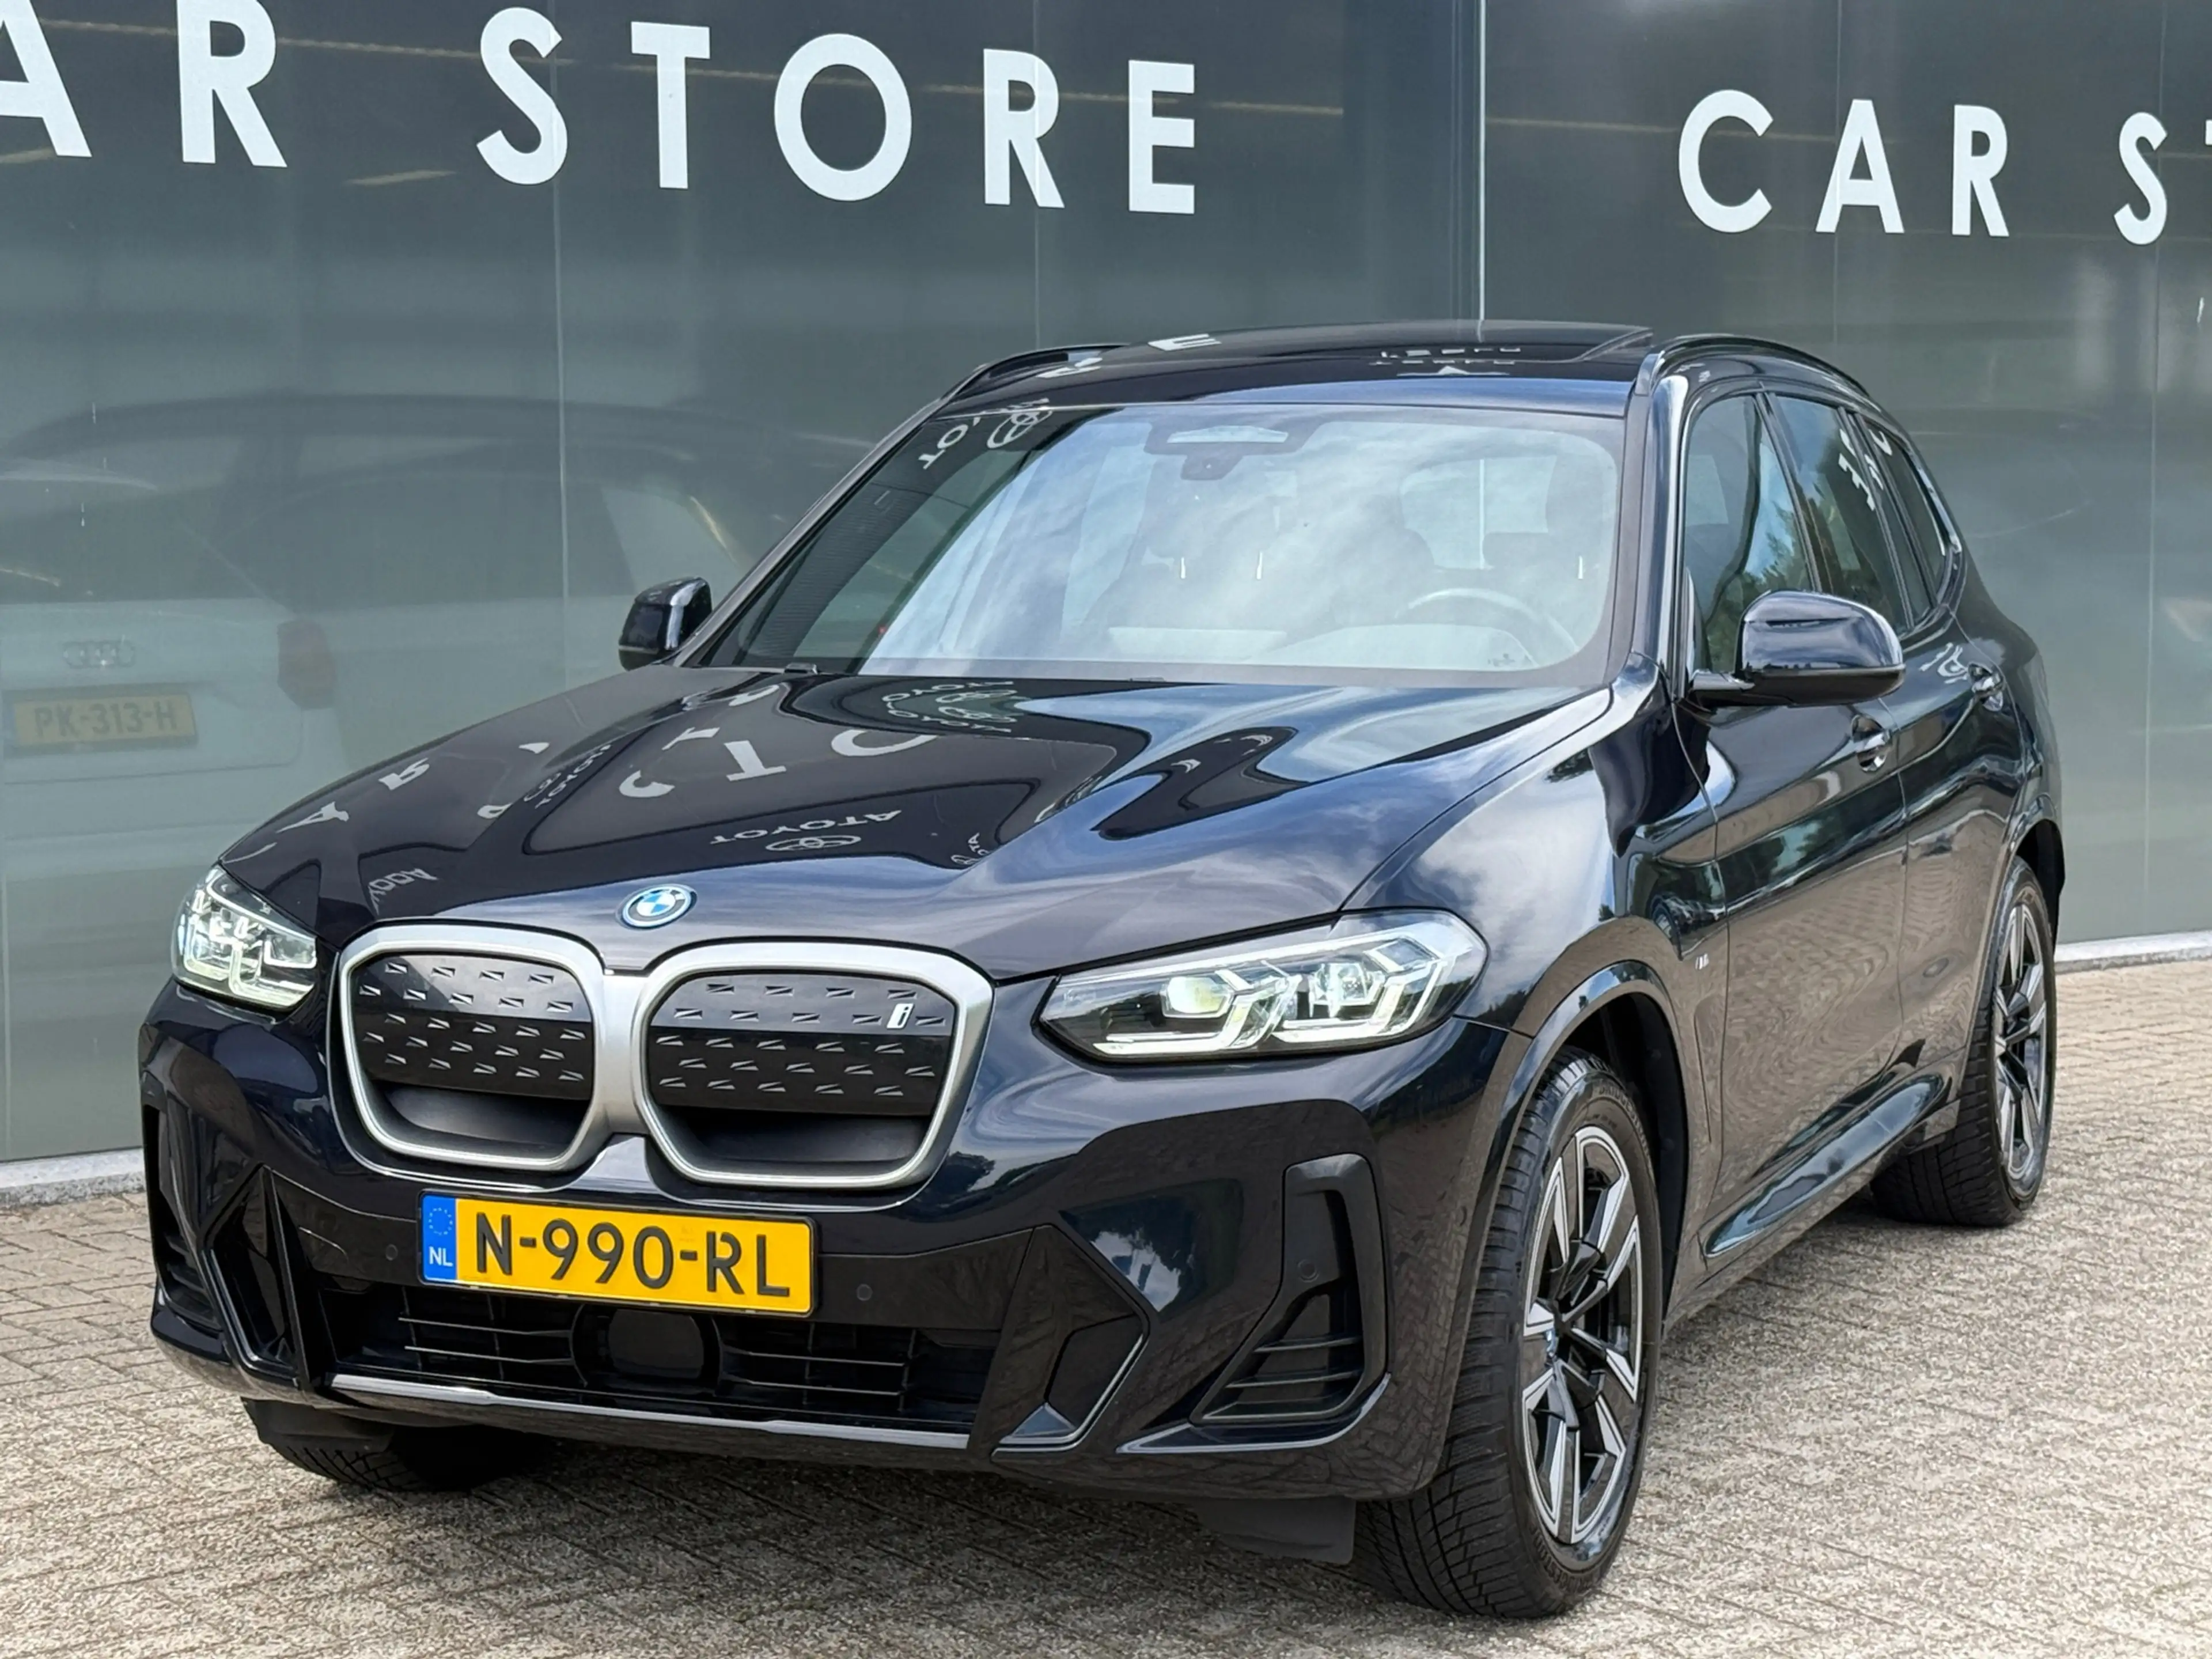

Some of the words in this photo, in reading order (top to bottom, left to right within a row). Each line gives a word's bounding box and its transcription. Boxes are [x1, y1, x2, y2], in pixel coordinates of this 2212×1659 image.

[476, 7, 1195, 214] STORE
[1678, 89, 2010, 237] CAR
[2113, 112, 2212, 245] S
[34, 699, 177, 739] PK-313-H
[429, 1246, 454, 1267] NL
[475, 1211, 791, 1298] N-990-RL
